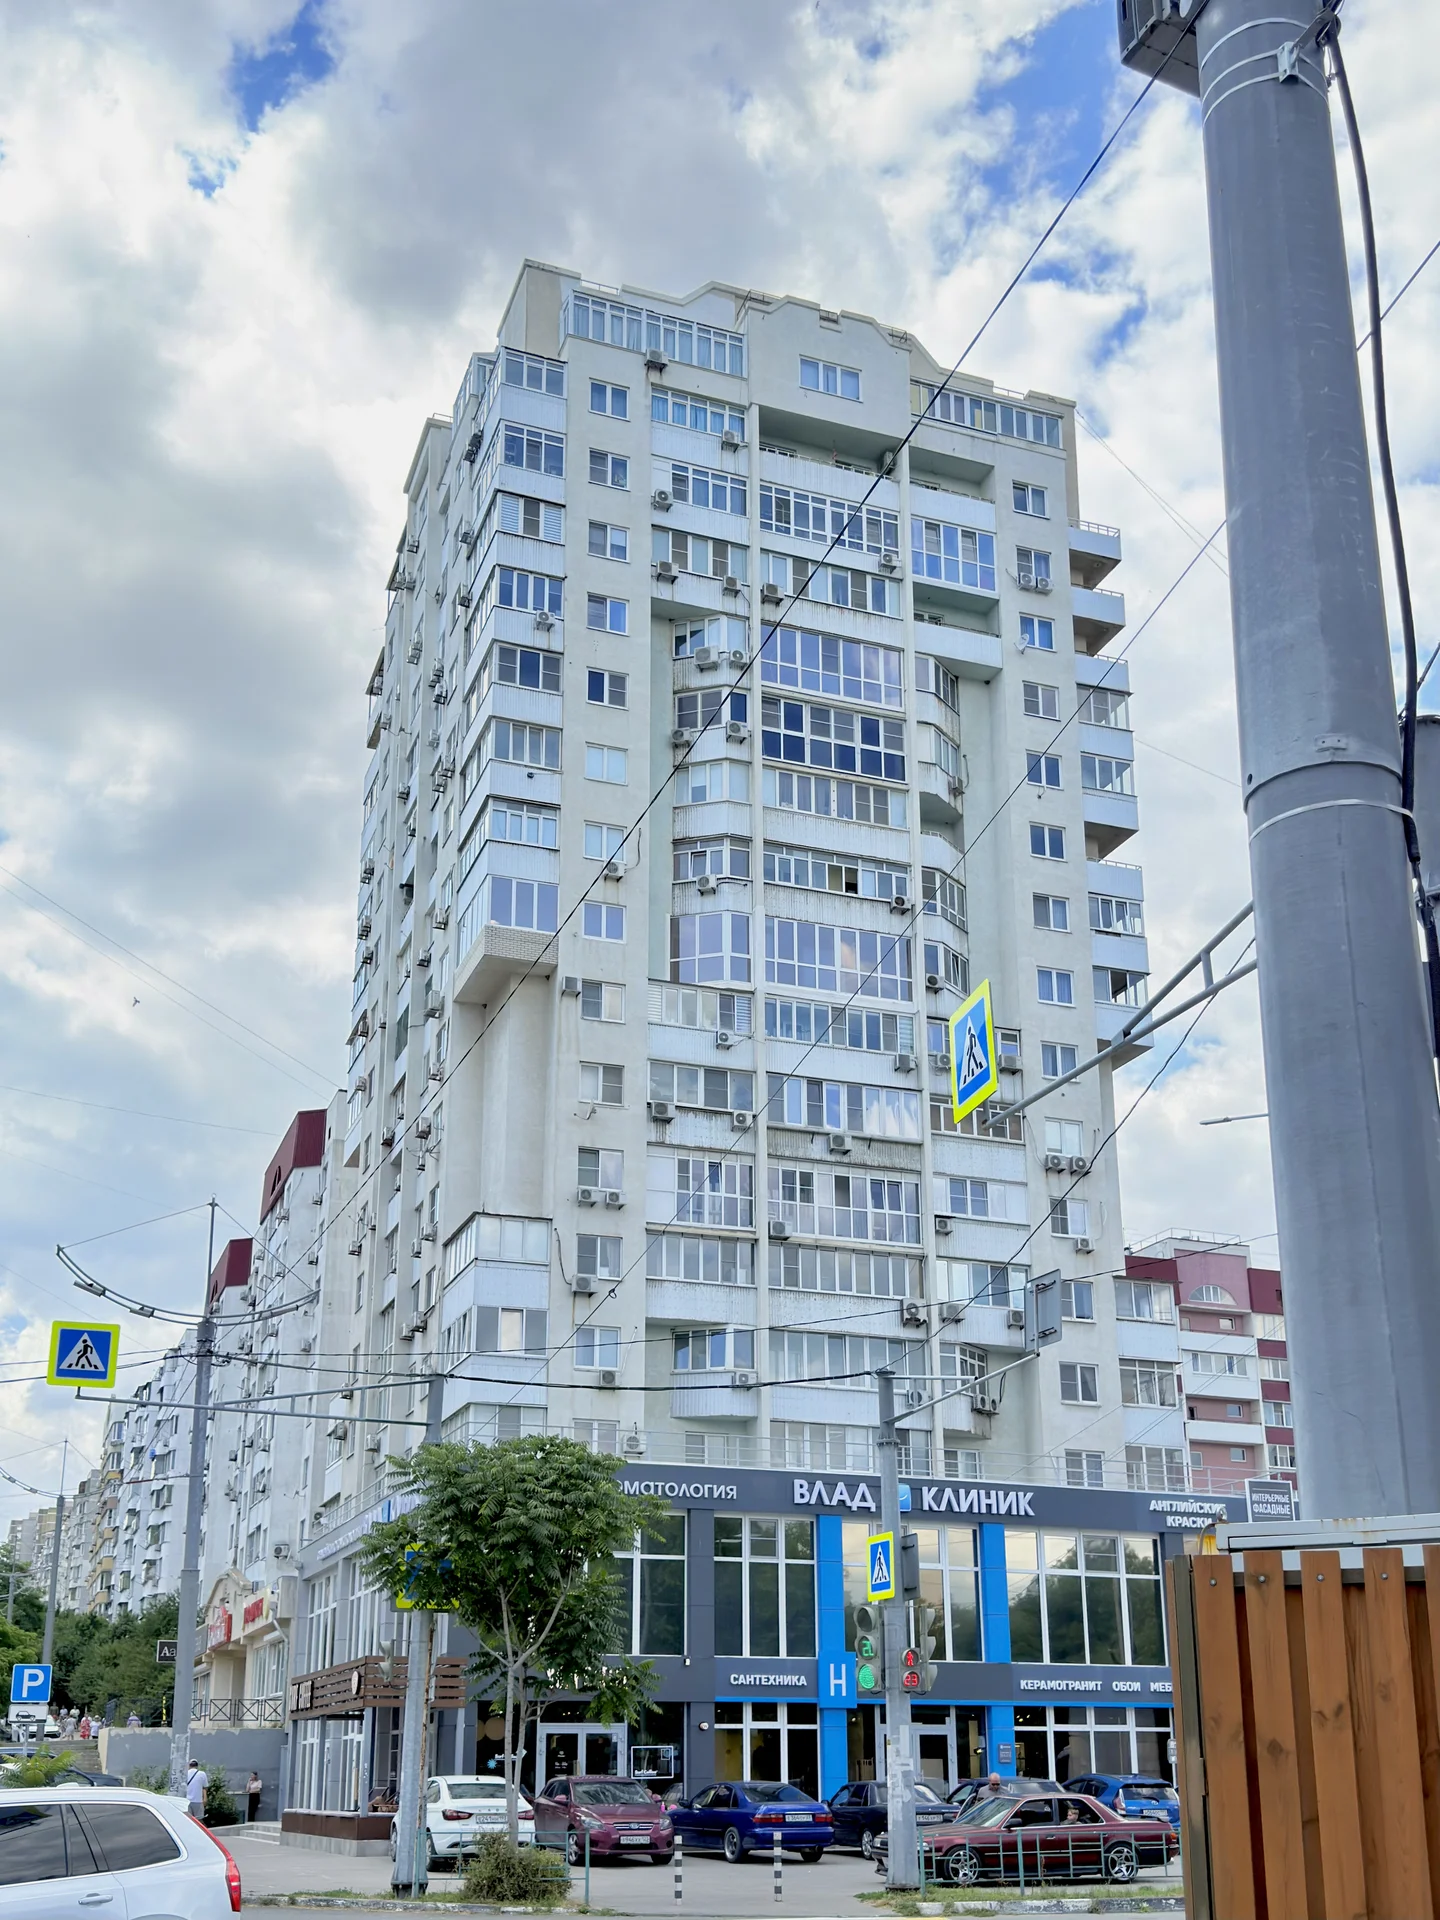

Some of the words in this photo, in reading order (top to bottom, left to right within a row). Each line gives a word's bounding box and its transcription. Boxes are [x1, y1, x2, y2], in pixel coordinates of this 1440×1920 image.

[793, 1479, 876, 1512] ВЛАД
[921, 1486, 1036, 1517] КЛИНИК
[1251, 1493, 1290, 1503] ИНТЕРЬЕРНЫЕ
[1252, 1503, 1291, 1515] ФАСАДНЫЕ
[1166, 1515, 1213, 1529] КРАСКИ
[22, 1669, 45, 1698] P
[730, 1673, 808, 1686] САНТЕХНИКА
[904, 1674, 918, 1687] 23
[1020, 1679, 1103, 1692] КЕРАМОГРАНИТ
[1112, 1681, 1141, 1692] ОБОИ
[1150, 1682, 1173, 1693] МЕБ
